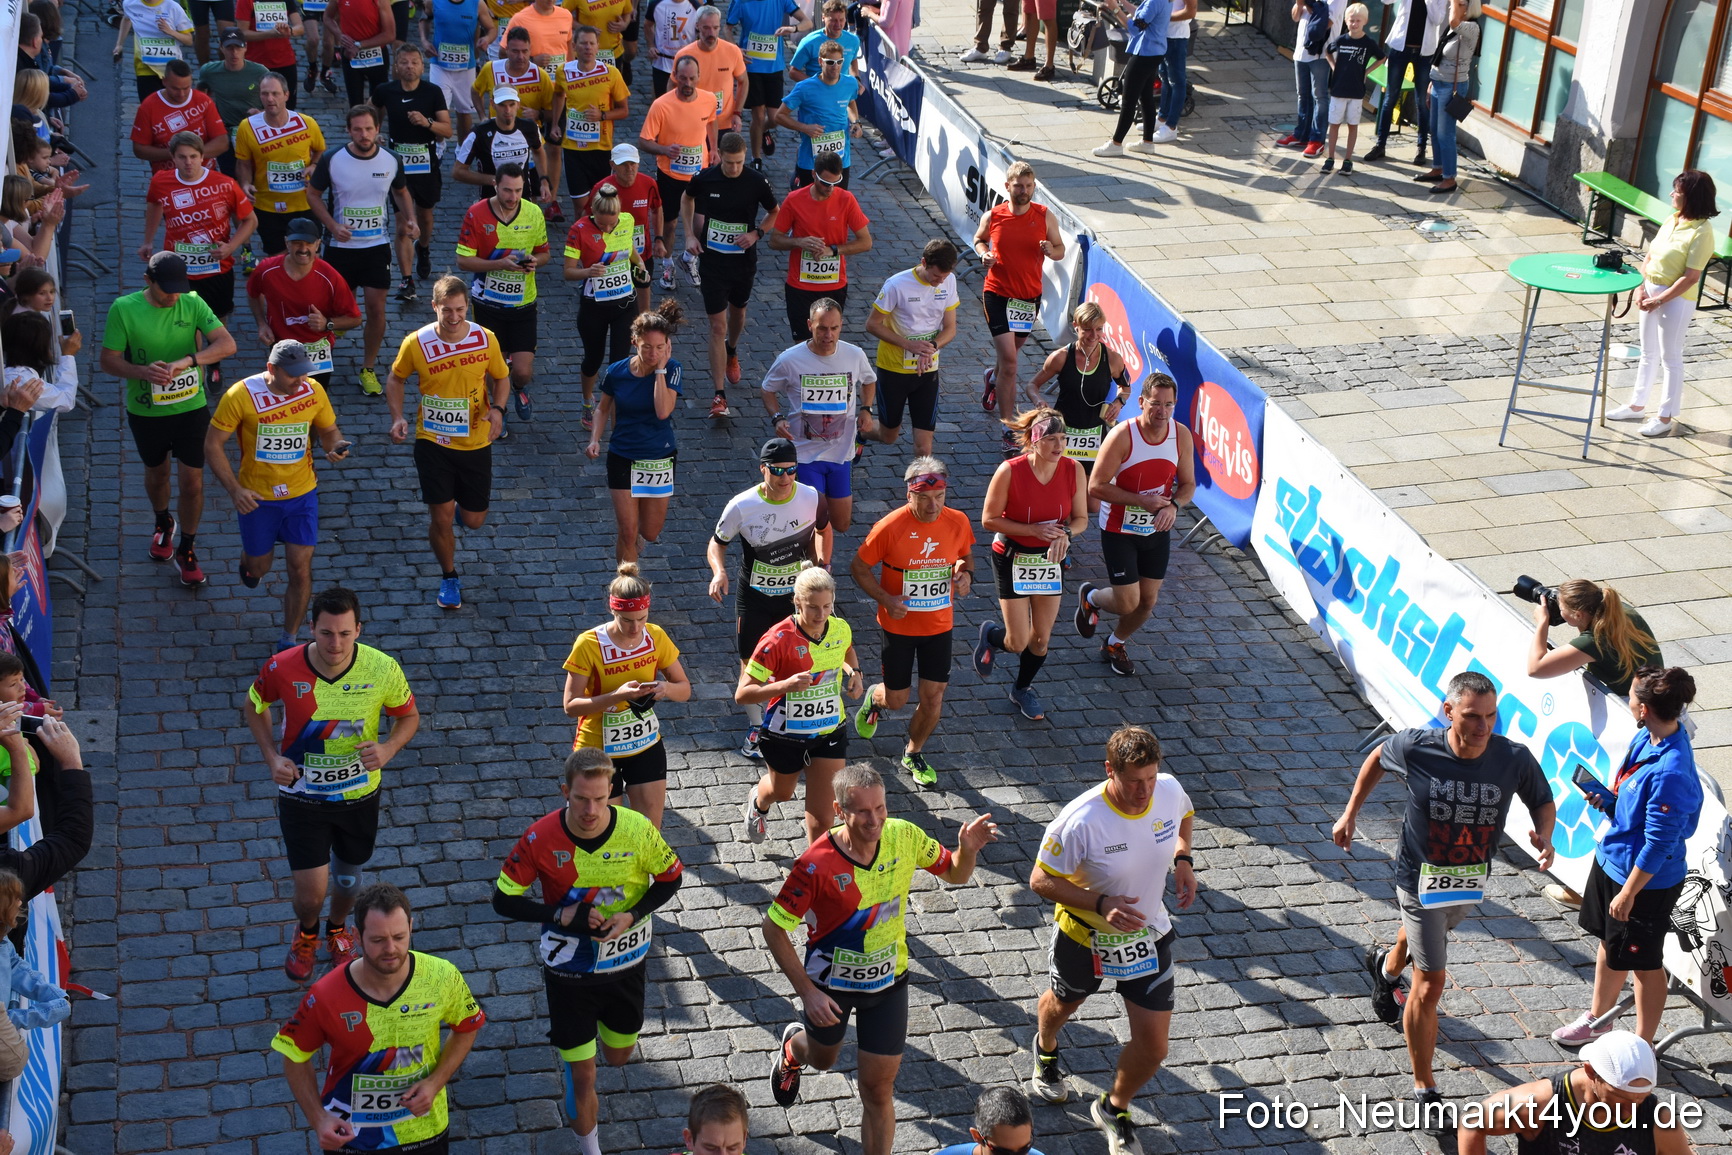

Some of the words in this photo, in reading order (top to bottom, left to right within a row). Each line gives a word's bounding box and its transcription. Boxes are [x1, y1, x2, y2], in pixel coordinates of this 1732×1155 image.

[259, 12, 285, 22] 2664
[145, 47, 173, 56] 2744
[751, 42, 775, 52] 1379
[442, 53, 467, 62] 2535
[519, 85, 541, 94] BÖGL
[567, 82, 586, 91] MAX
[588, 77, 611, 86] BÖGL
[569, 121, 596, 132] 2403
[260, 142, 284, 154] MAX
[286, 133, 311, 146] BÖGL
[816, 142, 842, 154] 2480
[270, 161, 302, 171] BOCK
[674, 154, 701, 165] 2532
[272, 172, 303, 183] 2398
[346, 208, 380, 217] BOCK
[348, 217, 379, 229] 2715
[711, 219, 747, 232] BOCK
[711, 231, 740, 244] 278
[805, 261, 834, 273] 1204
[489, 271, 524, 282] BOCK
[598, 274, 628, 289] 2689
[489, 280, 522, 294] 2688
[606, 288, 625, 297] NINA
[428, 360, 456, 375] MAX
[460, 353, 490, 366] BÖGL
[805, 377, 844, 387] BOCK
[160, 389, 193, 401] ANDREAS
[806, 389, 842, 401] 2771
[425, 398, 464, 409] BOCK
[258, 409, 288, 424] MAX
[290, 398, 318, 414] BÖGL
[427, 409, 464, 424] 2404
[262, 424, 305, 434] BOCK
[432, 424, 458, 432] PATRIK
[1194, 387, 1253, 485] Hervis
[262, 437, 303, 451] 2390
[1065, 437, 1096, 449] 1195
[635, 461, 671, 470] BOCK
[1200, 446, 1225, 476] SPORTS
[636, 472, 670, 485] 2772
[789, 520, 799, 528] TV
[1129, 513, 1156, 525] 257
[1132, 526, 1155, 534] OLIVE
[908, 558, 947, 566] funrunners
[756, 564, 798, 574] BOCK
[908, 568, 949, 581] BOCK
[1018, 567, 1056, 581] 2575
[756, 575, 797, 588] 2648
[1022, 582, 1052, 591] ANDREA
[909, 582, 947, 597] 2160
[909, 598, 945, 607] HARTMUT
[604, 665, 631, 676] MAX
[633, 656, 658, 670] BÖGL
[791, 685, 834, 699] BOCK
[793, 700, 834, 718] 2845
[800, 720, 834, 728] LAURA
[610, 720, 652, 742] 2381
[308, 752, 360, 767] BOCK
[311, 763, 361, 783] 2683
[317, 778, 361, 792] DOMINIK
[1429, 779, 1502, 806] MUD
[1429, 800, 1499, 825] DER
[1152, 821, 1164, 831] 20
[1043, 837, 1063, 857] 20
[1104, 843, 1128, 853] BOCK
[1426, 877, 1478, 890] 2825
[605, 927, 646, 957] 2681
[547, 936, 568, 962] 7
[1099, 941, 1150, 963] 2158
[612, 949, 640, 967] MAXI
[839, 947, 892, 965] BOCK
[839, 961, 891, 980] 2690
[1102, 961, 1153, 976] BERNHARD
[844, 978, 887, 988] HELMUTH
[360, 1094, 403, 1110] 267
